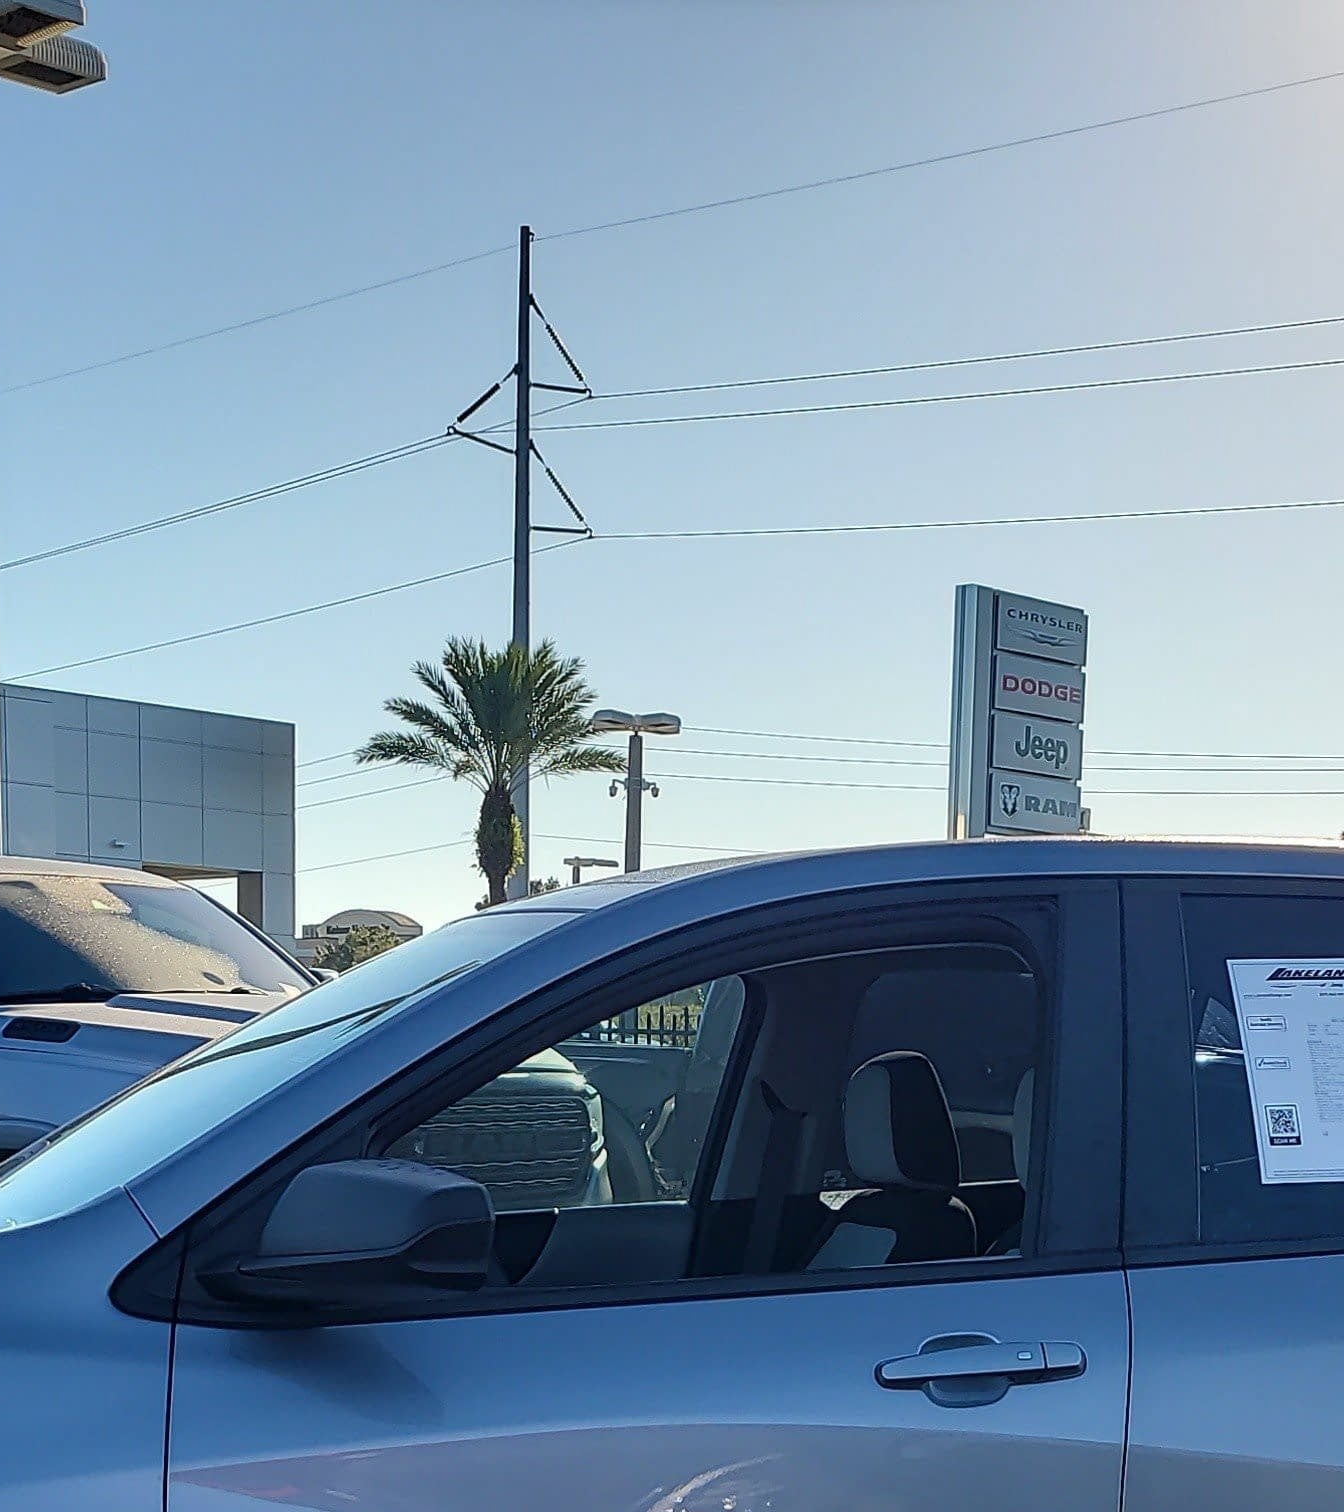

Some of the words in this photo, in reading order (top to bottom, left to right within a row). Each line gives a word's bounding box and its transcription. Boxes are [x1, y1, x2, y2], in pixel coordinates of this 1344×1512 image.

[1007, 608, 1083, 633] CHRYSLER
[1002, 675, 1081, 703] DODGE
[1015, 726, 1068, 769] Jeep
[1024, 795, 1077, 818] RAM
